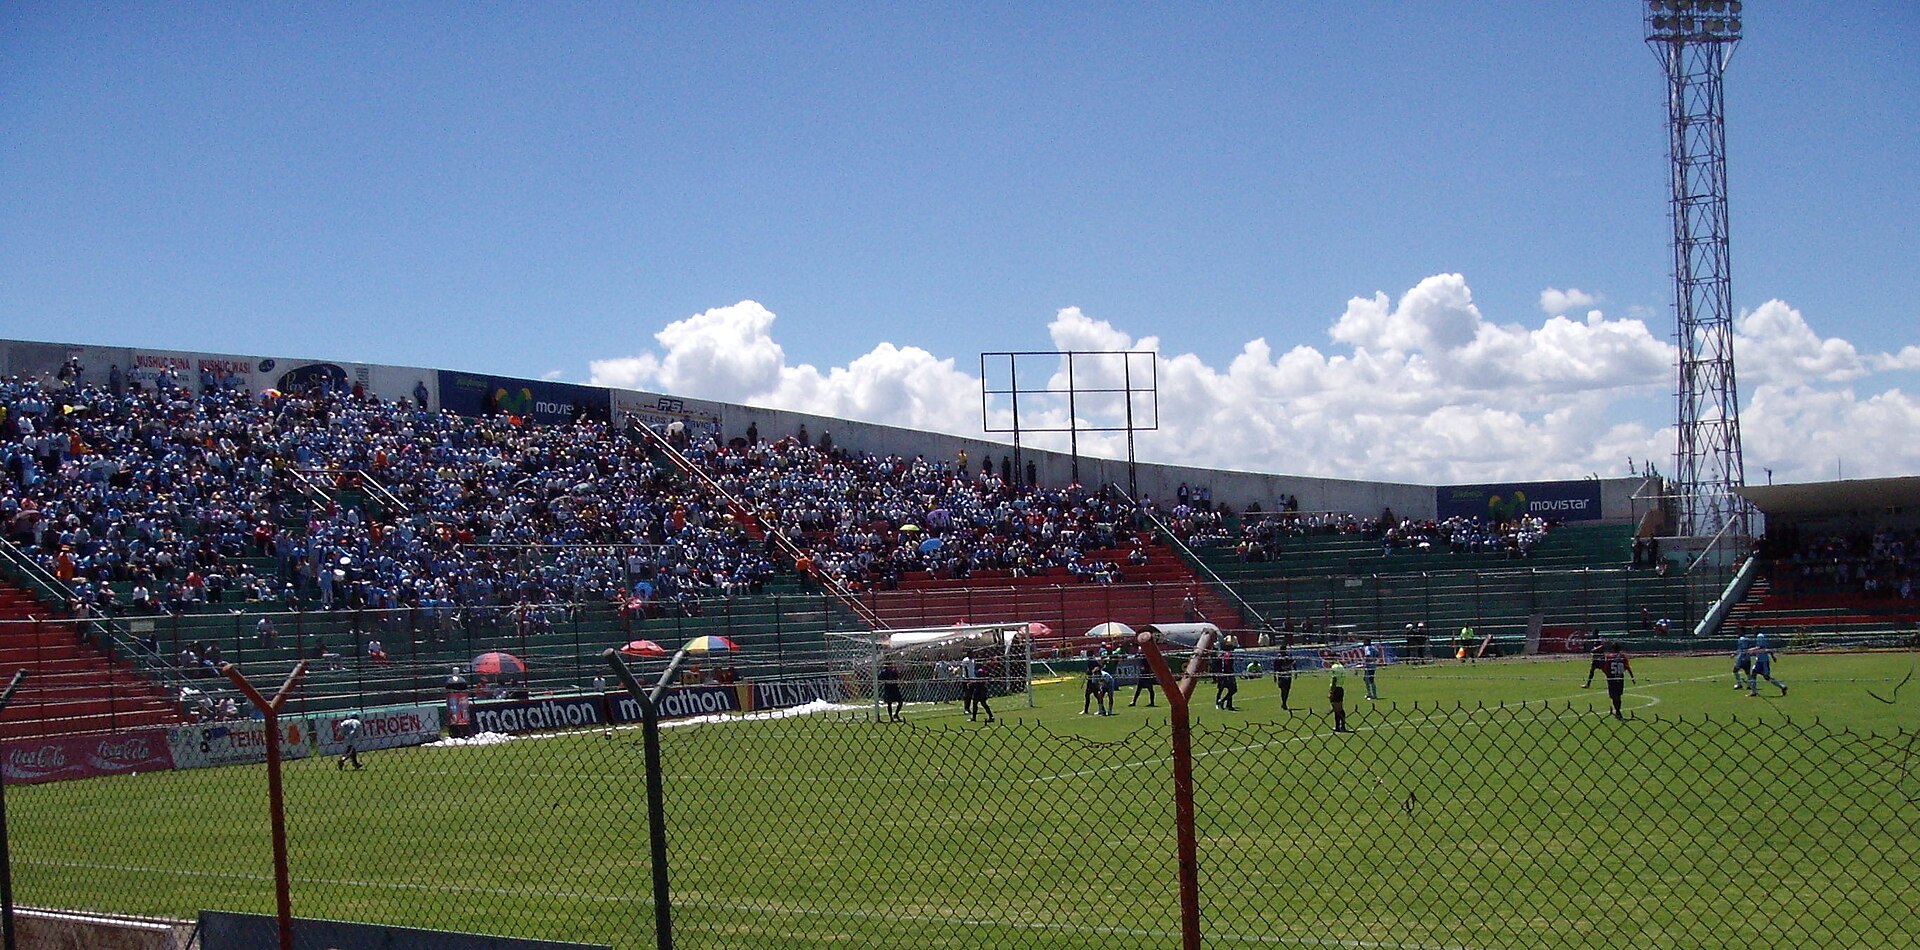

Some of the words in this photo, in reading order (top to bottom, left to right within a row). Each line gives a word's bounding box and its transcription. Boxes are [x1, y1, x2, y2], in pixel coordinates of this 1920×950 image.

[1530, 499, 1590, 511] movistar
[475, 701, 597, 732] marathon
[620, 689, 730, 720] mrathon
[362, 713, 421, 737] ITROËN
